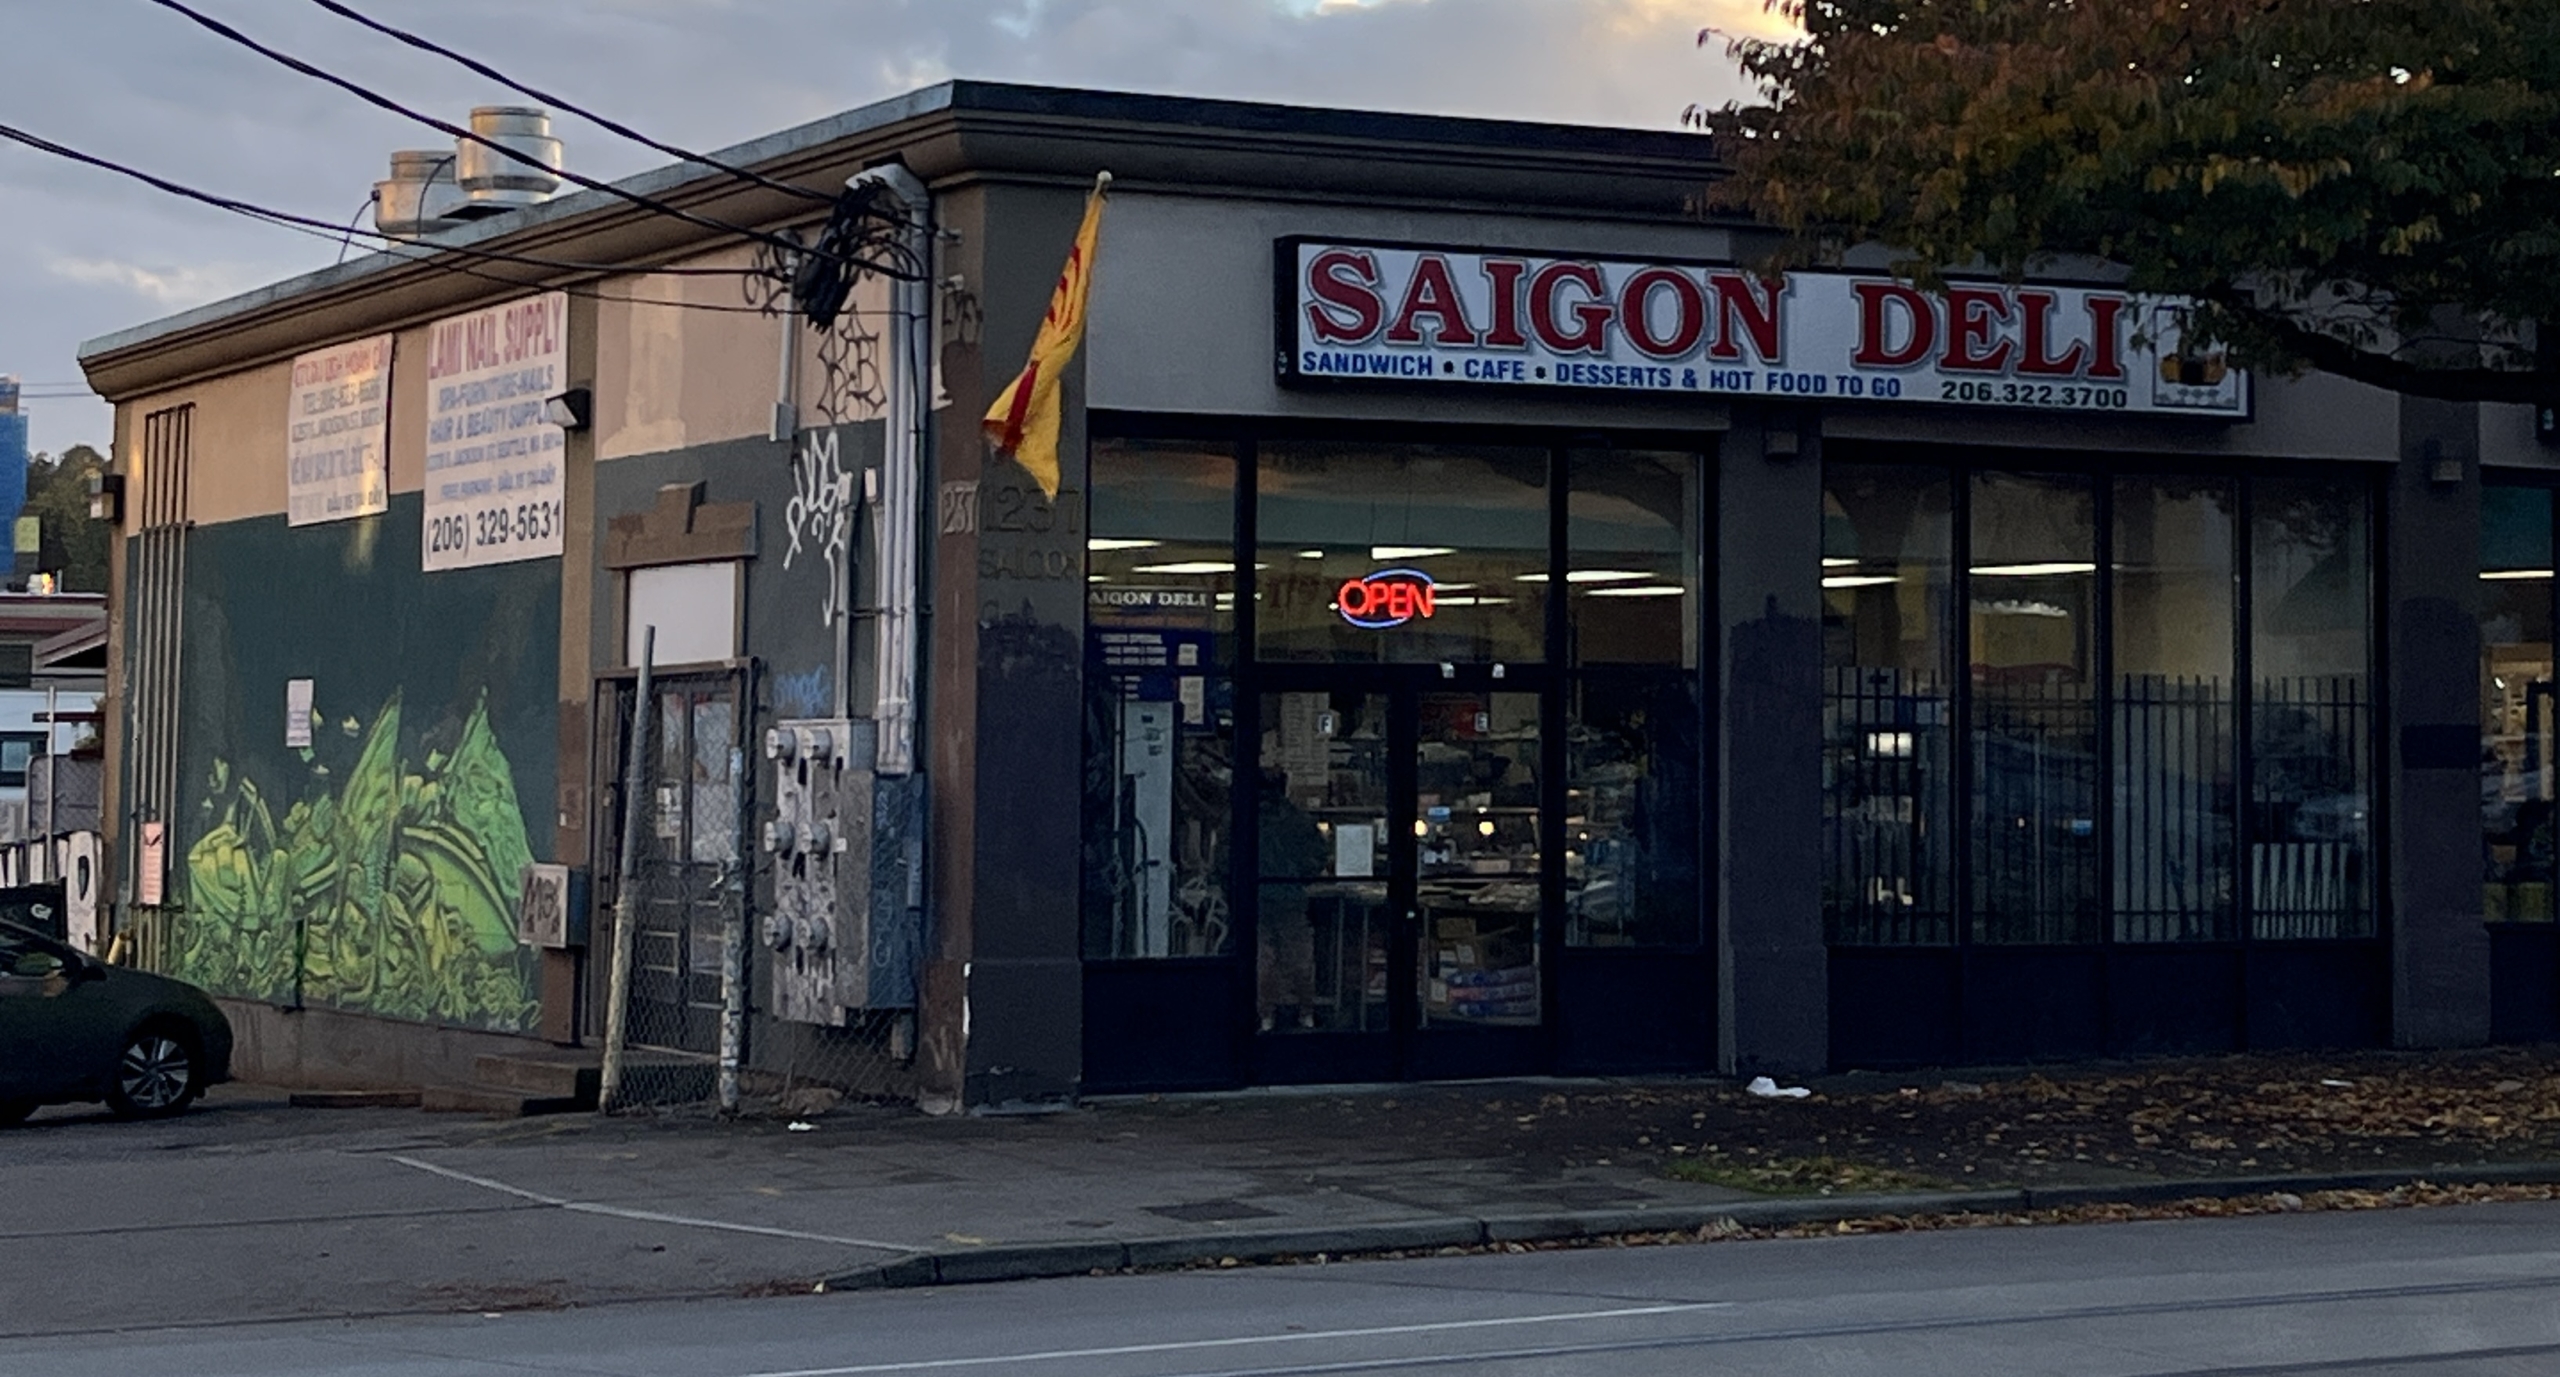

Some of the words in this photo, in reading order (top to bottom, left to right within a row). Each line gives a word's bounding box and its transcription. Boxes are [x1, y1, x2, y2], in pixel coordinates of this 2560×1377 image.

[467, 313, 500, 371] NAIL
[505, 296, 564, 363] SUPPLY
[1307, 248, 1793, 362] SAIGON
[1850, 279, 2127, 381] DELI
[1302, 351, 1433, 377] SANDWICH
[1464, 358, 1526, 381] CAFE
[1556, 363, 1672, 389] DESSERTS
[1682, 366, 1698, 388] &
[1710, 369, 1754, 391] HOT
[1766, 371, 1828, 395] FOOD
[1836, 374, 1864, 396] TO
[1872, 376, 1901, 398] GO
[1941, 381, 2128, 409] 206.322.3700
[427, 513, 470, 562] (206)
[476, 500, 562, 547] 329-5631
[1158, 592, 1207, 607] DELI
[1338, 580, 1435, 617] OPEN
